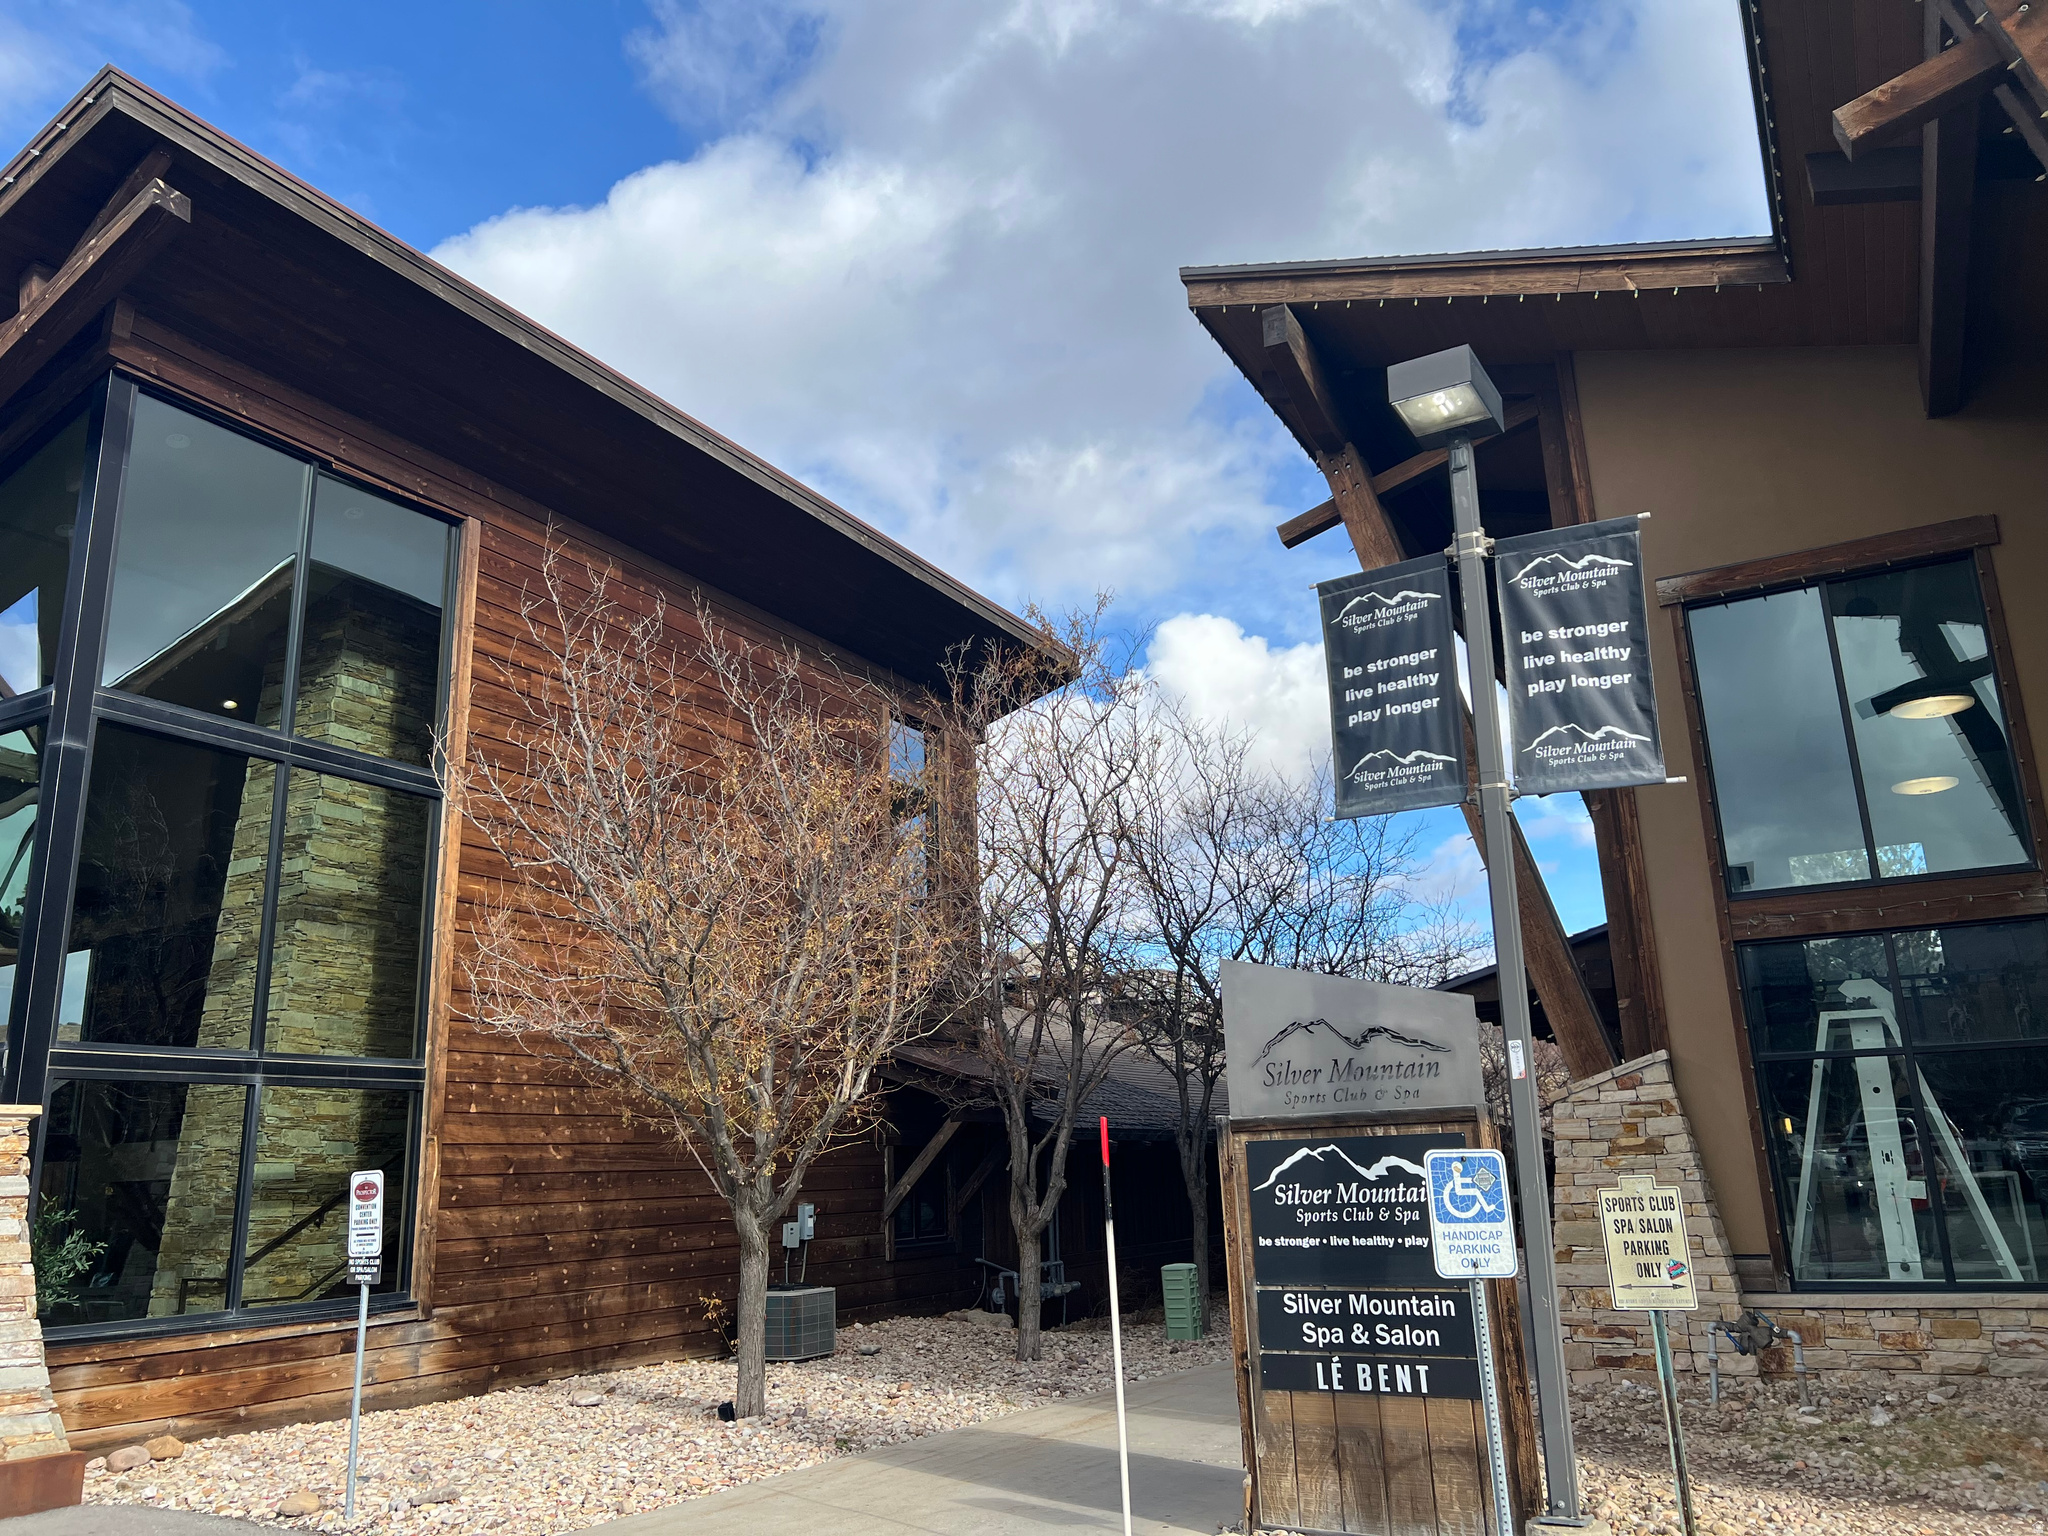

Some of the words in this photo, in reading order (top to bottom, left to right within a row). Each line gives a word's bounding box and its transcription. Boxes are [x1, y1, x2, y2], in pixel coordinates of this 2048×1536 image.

[1520, 575, 1555, 589] Silver
[1557, 565, 1618, 584] Mountain
[1533, 586, 1559, 598] Sports
[1561, 581, 1580, 592] Club
[1582, 581, 1589, 589] &
[1591, 579, 1606, 590] Spa
[1342, 612, 1372, 628] Silver
[1374, 599, 1428, 620] Mountain
[1354, 622, 1375, 634] Sports
[1378, 617, 1394, 627] Club
[1404, 612, 1418, 622] Spa
[1521, 631, 1543, 644] be
[1549, 621, 1628, 639] stronger
[1344, 666, 1362, 678] be
[1367, 648, 1438, 673] stronger
[1523, 656, 1555, 669] live
[1560, 646, 1631, 663] healthy
[1346, 688, 1373, 702] live
[1378, 673, 1439, 694] healthy
[1528, 679, 1566, 696] play
[1571, 673, 1631, 689] longer
[1348, 708, 1380, 727] play
[1386, 697, 1440, 715] longer
[1535, 746, 1572, 759] Silver
[1573, 738, 1636, 754] Mountain
[1549, 757, 1575, 766] Sports
[1578, 753, 1597, 763] Club
[1609, 752, 1624, 761] Spa
[1354, 770, 1385, 784] Silver
[1387, 760, 1443, 778] Mountain
[1365, 782, 1388, 792] Sports
[1390, 776, 1407, 786] Club
[1418, 774, 1431, 784] Spa
[1264, 1061, 1322, 1087] Silver
[1328, 1054, 1440, 1084] Mountain
[1284, 1091, 1326, 1109] Sports
[1333, 1088, 1366, 1103] Club
[1375, 1087, 1388, 1100] &
[1394, 1086, 1420, 1104] Spa
[1274, 1184, 1331, 1205] Silver
[1336, 1181, 1427, 1205] Mountai
[1605, 1196, 1644, 1212] SPORTS
[1649, 1196, 1675, 1211] CLUB
[1296, 1208, 1338, 1226] Sports
[1342, 1206, 1373, 1222] Club
[1379, 1208, 1390, 1221] &
[1395, 1207, 1420, 1225] Spa
[1259, 1236, 1272, 1246] be
[1274, 1236, 1321, 1248] stronger
[1330, 1236, 1350, 1246] live
[1352, 1236, 1395, 1248] healthy
[1405, 1236, 1429, 1248] play
[1443, 1231, 1503, 1241] HANDICAP
[1624, 1240, 1669, 1255] PARKING
[1449, 1244, 1500, 1254] PARKING
[1461, 1258, 1490, 1268] ONLY
[1637, 1262, 1661, 1278] ONLY
[1283, 1293, 1342, 1314] Silver
[1349, 1294, 1455, 1317] Mountain
[1302, 1322, 1344, 1347] Spa
[1350, 1323, 1370, 1345] &
[1375, 1324, 1440, 1346] Salon
[1316, 1356, 1344, 1391] LÉ
[1356, 1363, 1429, 1394] BENT
